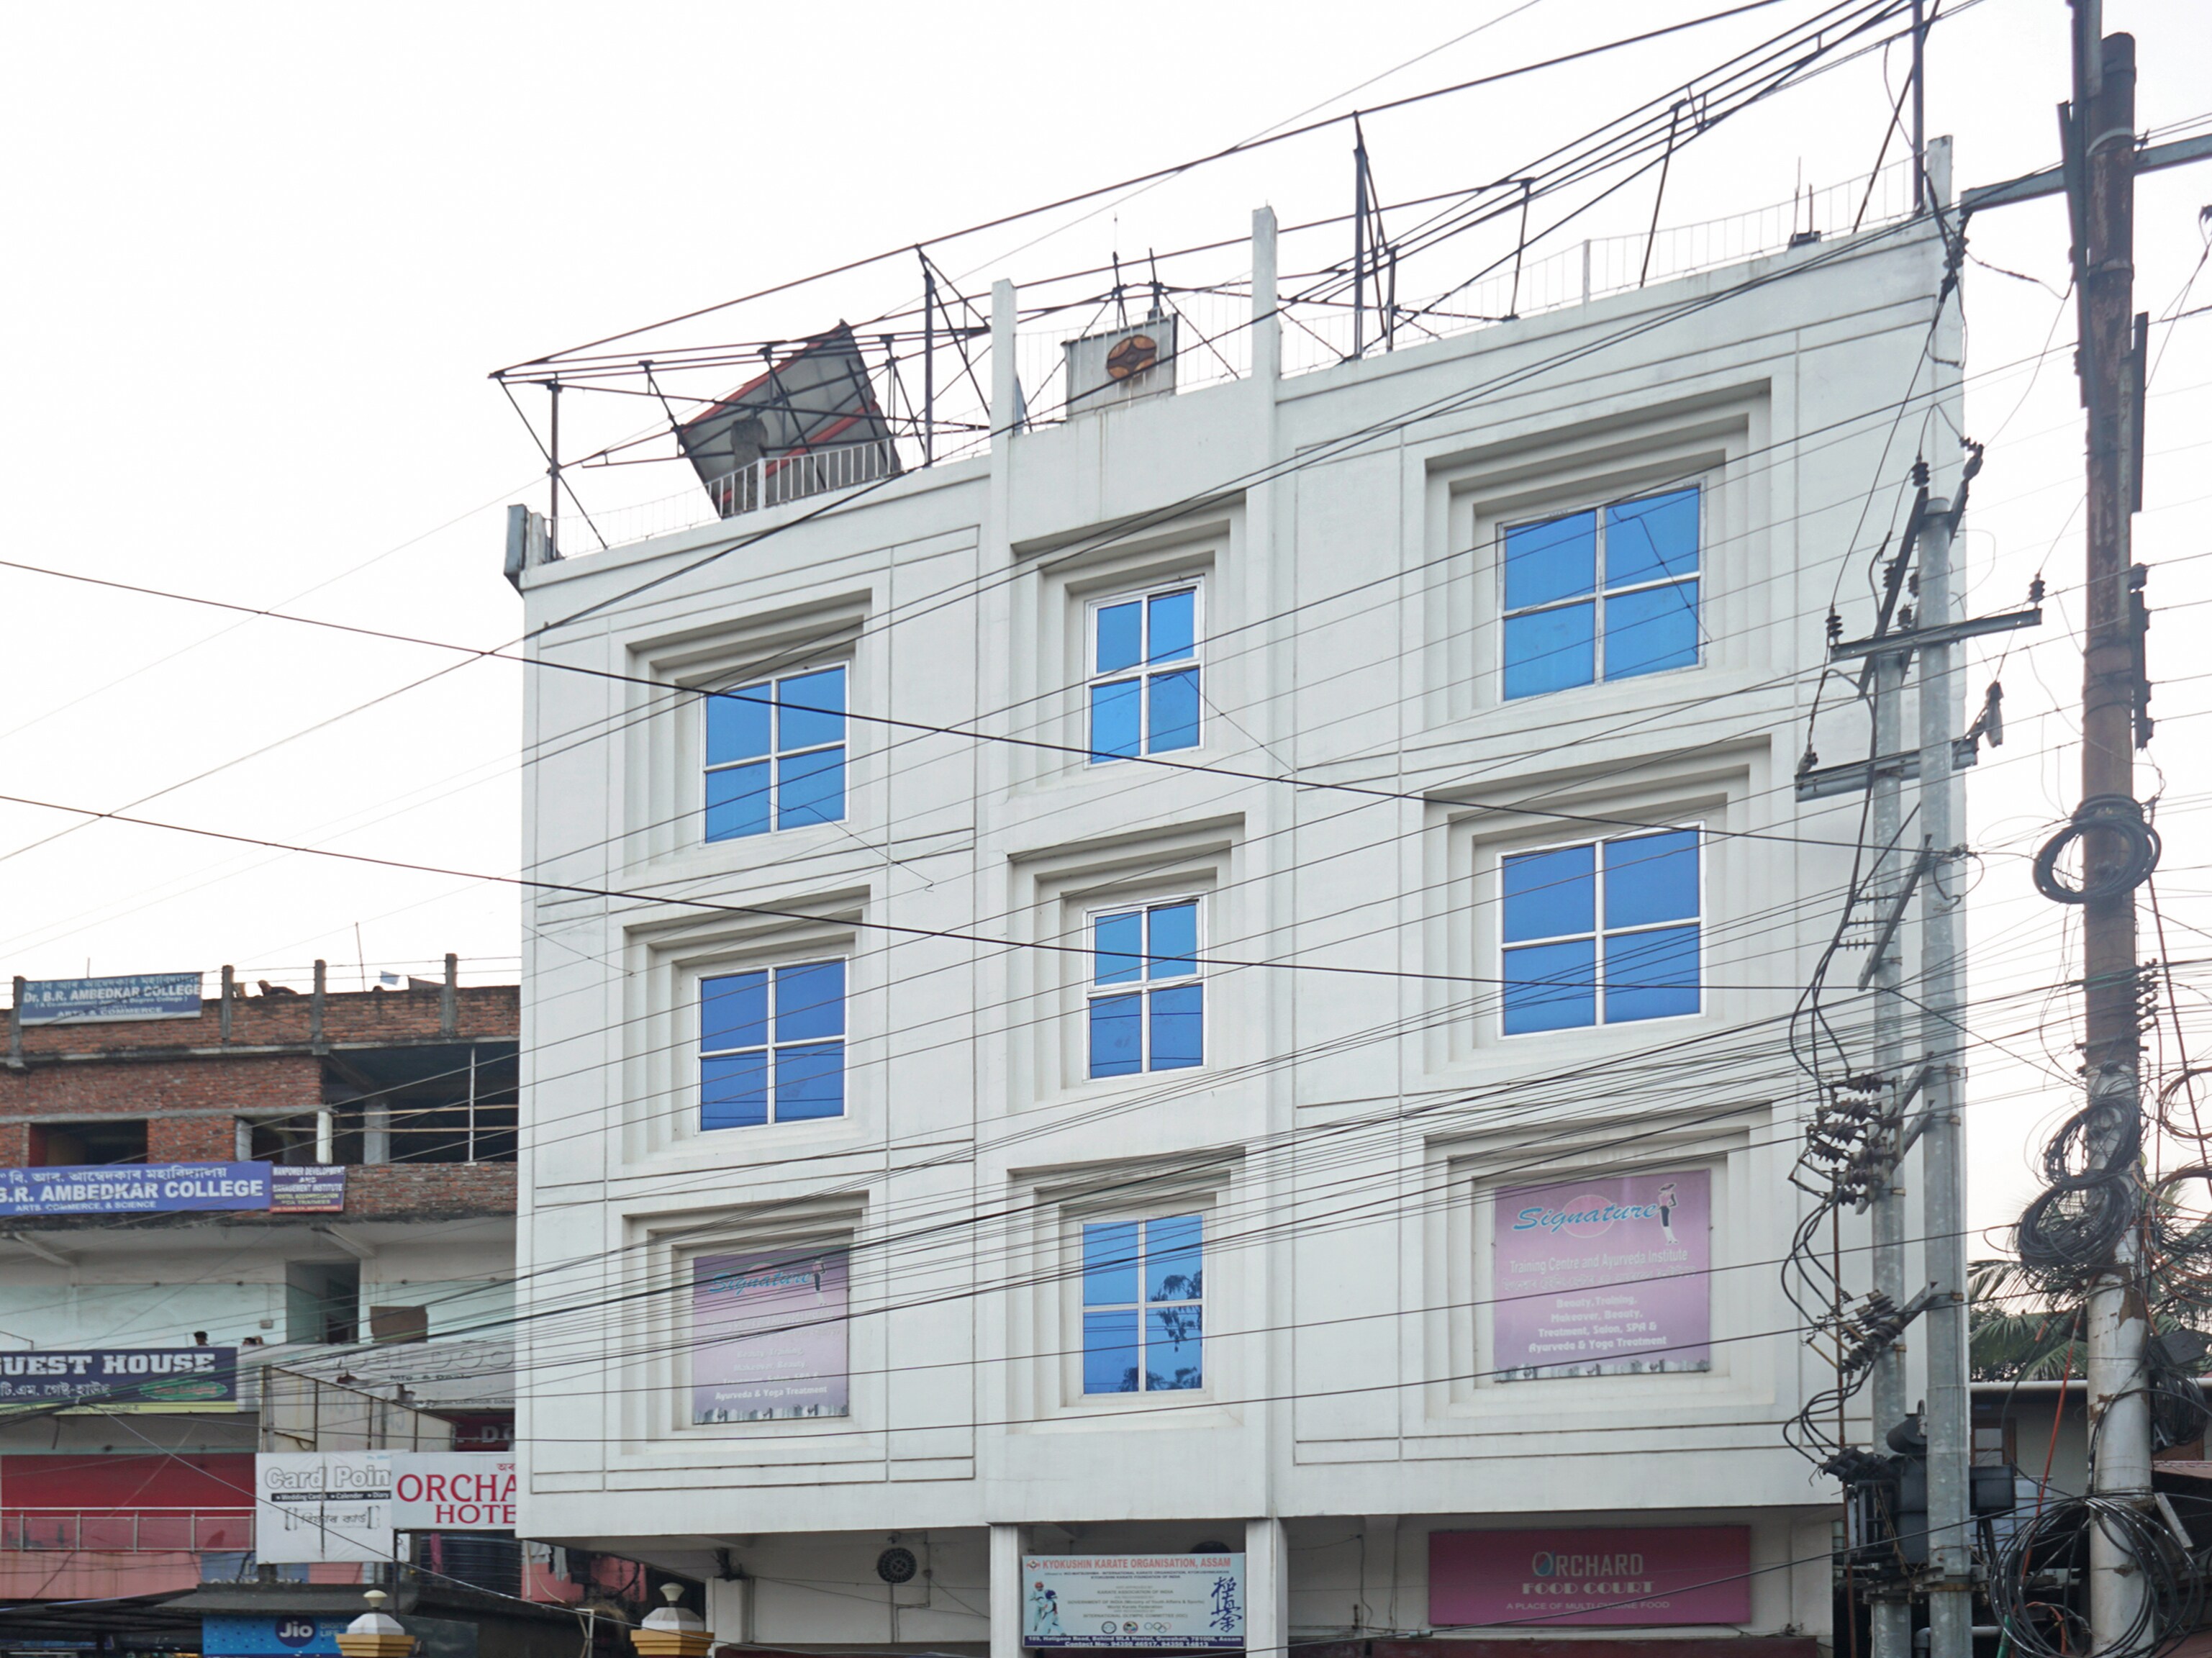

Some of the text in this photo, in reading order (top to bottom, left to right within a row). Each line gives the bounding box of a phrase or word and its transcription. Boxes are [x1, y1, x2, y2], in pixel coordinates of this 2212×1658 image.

[24, 984, 200, 1003] Dr. B.R. AMBEDKAR COLLEGE
[100, 1006, 163, 1016] COMMERCE
[40, 1182, 159, 1202] AMBEDKAR
[165, 1180, 263, 1198] COLLEGE
[115, 1200, 156, 1209] SCIENCE
[1513, 1204, 1658, 1234] Signature
[1510, 1249, 1688, 1274] Training Centre and Ayurveda Institute
[708, 1272, 812, 1296] Signature
[1528, 1341, 1576, 1354] Ayurveda
[1588, 1339, 1614, 1351] Yoga
[1615, 1336, 1667, 1348] Treatment
[0, 1353, 216, 1376] UEST HOUSE
[715, 1385, 828, 1402] Ayurveda & Yoga Treatment
[265, 1464, 391, 1490] Card Poin
[397, 1474, 516, 1502] ORCHA
[435, 1505, 516, 1523] HOTE
[1043, 1557, 1230, 1569] KYOKUSHIN KARATE ORGANISATION, ASSAM
[1531, 1550, 1644, 1577] ORCHARD
[1521, 1581, 1654, 1595] FOOD COURT
[1641, 1600, 1670, 1609] FOOD
[279, 1621, 313, 1637] Jio
